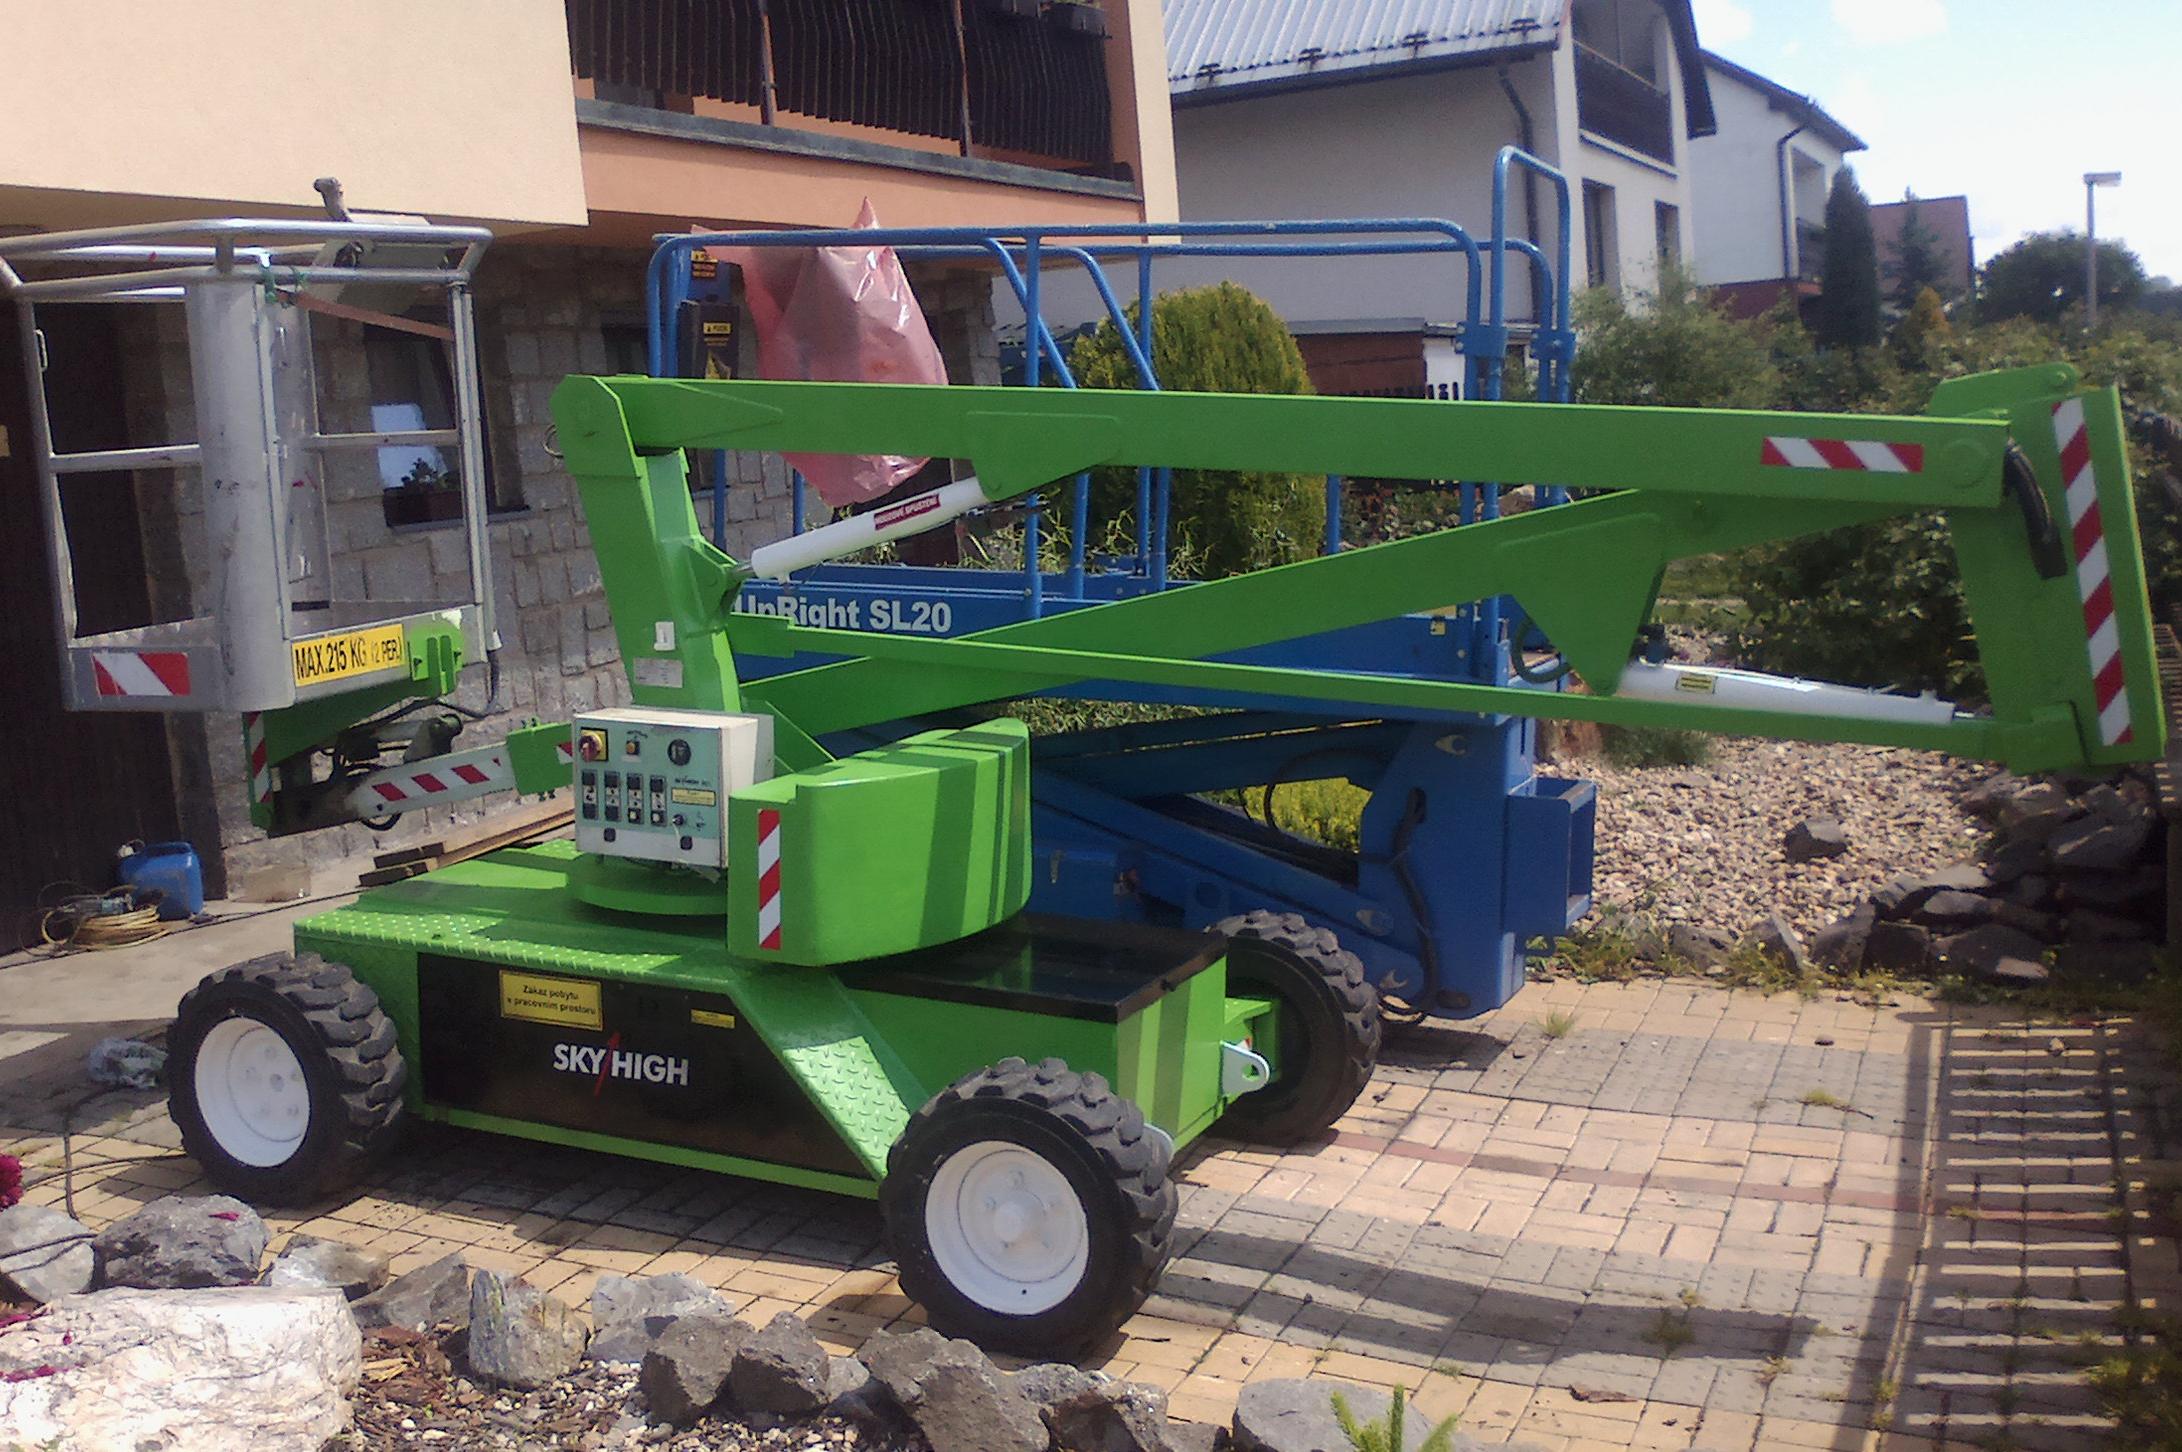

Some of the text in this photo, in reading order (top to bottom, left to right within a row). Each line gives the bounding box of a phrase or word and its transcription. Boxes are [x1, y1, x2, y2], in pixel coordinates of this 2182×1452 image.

[734, 595, 952, 632] UpRight SL20
[350, 638, 366, 668] KG
[611, 1050, 689, 1086] HIGH
